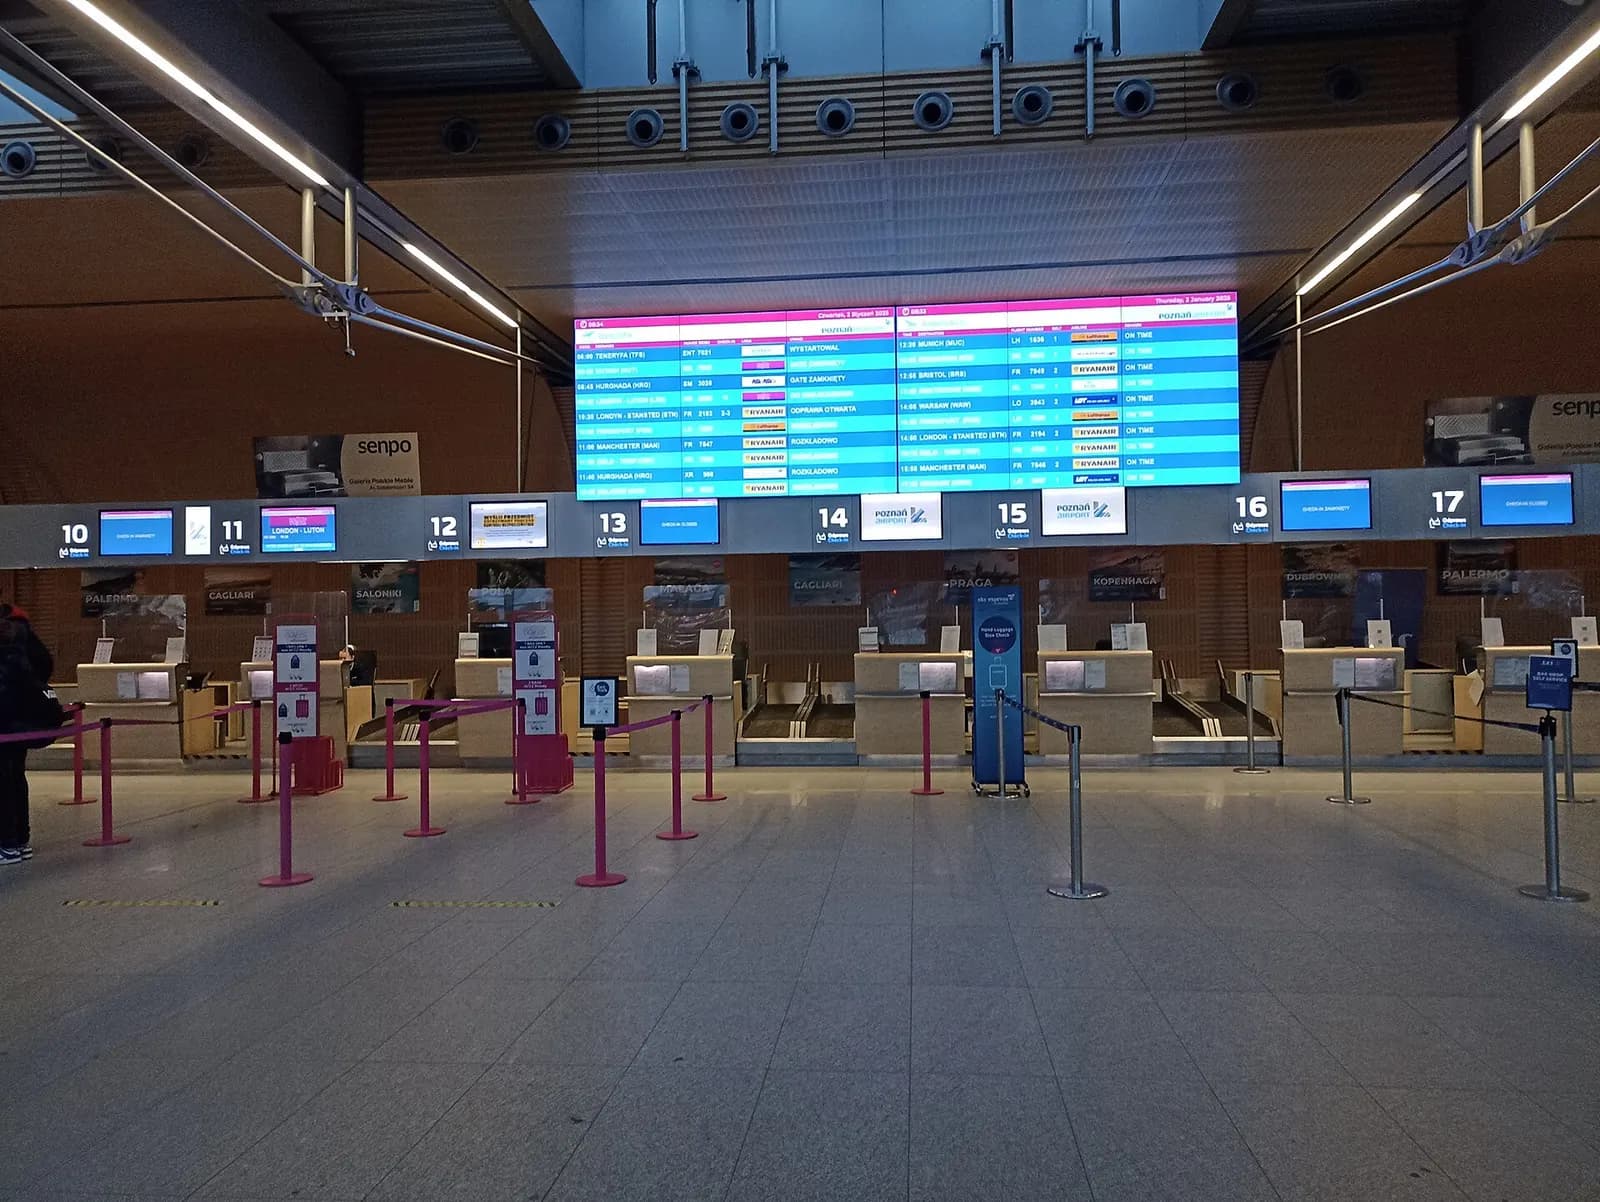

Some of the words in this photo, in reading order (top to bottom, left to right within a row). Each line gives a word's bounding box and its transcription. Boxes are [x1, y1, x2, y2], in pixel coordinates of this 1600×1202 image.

[1137, 331, 1153, 339] TIME
[1079, 365, 1116, 373] RYANAIR
[1138, 394, 1153, 402] TIME
[750, 408, 784, 416] RYANAIR
[1080, 428, 1116, 436] RYANAIR
[1138, 426, 1154, 434] TIME
[919, 433, 948, 441] LONDON
[358, 438, 412, 457] senpo
[596, 442, 641, 450] MANCHESTER
[751, 454, 784, 462] RYANAIR
[1081, 459, 1117, 467] RYANAIR
[920, 464, 966, 472] MANCHESTER
[1432, 490, 1464, 513] 17
[1236, 496, 1268, 518] 16
[819, 507, 849, 528] 14
[998, 503, 1027, 524] 15
[430, 516, 457, 536] 12
[600, 512, 627, 533] 13
[62, 524, 88, 544] 10
[222, 521, 242, 540] 11
[1442, 569, 1509, 581] PALERMO
[794, 580, 843, 590] CAGLIARI
[950, 578, 993, 589] PRAGA
[1093, 576, 1157, 586] KOPENHAGA
[85, 593, 138, 604] PALERMO
[209, 591, 255, 600] CAGLIARI
[356, 589, 402, 599] SALONIKI
